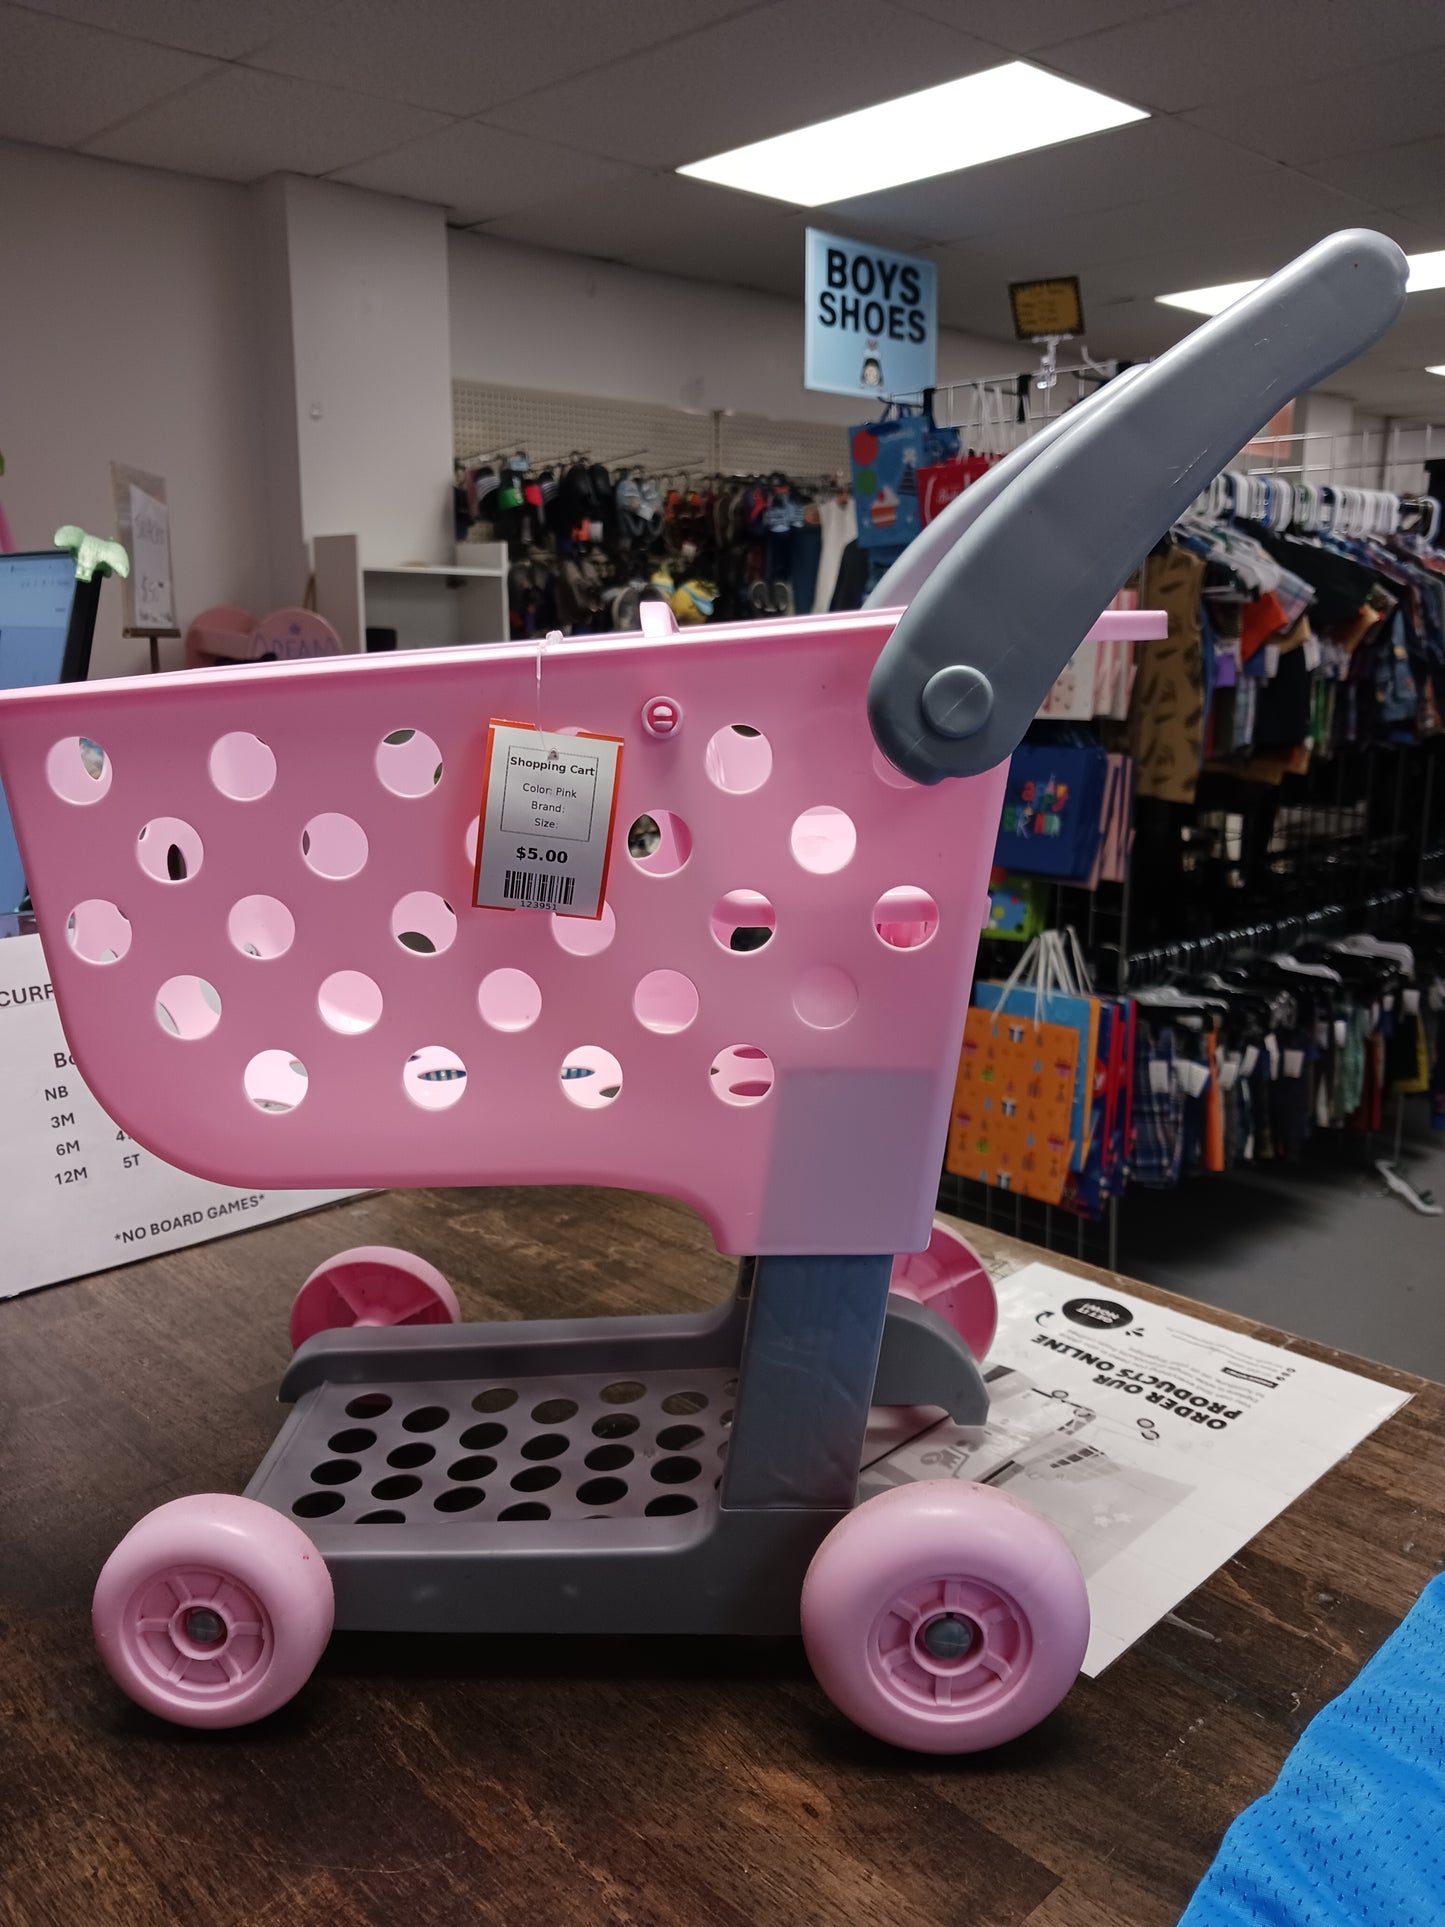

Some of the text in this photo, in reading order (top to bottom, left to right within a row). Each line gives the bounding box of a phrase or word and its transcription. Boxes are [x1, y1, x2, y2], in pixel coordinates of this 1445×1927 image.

[827, 249, 921, 306] BOYS
[819, 292, 926, 345] SHOES
[510, 757, 596, 776] Shopping Cart
[522, 783, 577, 799] Color: Pink
[531, 801, 565, 814] Brand:
[534, 818, 559, 829] Size:
[516, 846, 568, 864] $5.00
[520, 900, 558, 911] 123951
[45, 1085, 69, 1101] NB
[51, 1112, 75, 1128] 3M
[56, 1139, 80, 1156] 6M
[123, 1153, 140, 1168] 5T
[54, 1166, 88, 1185] 12M
[150, 1210, 204, 1236] BOARD
[1031, 1333, 1115, 1372] ONLINE
[1092, 1374, 1228, 1430] ORDER OUR
[1117, 1368, 1243, 1420] PRODUCTS
